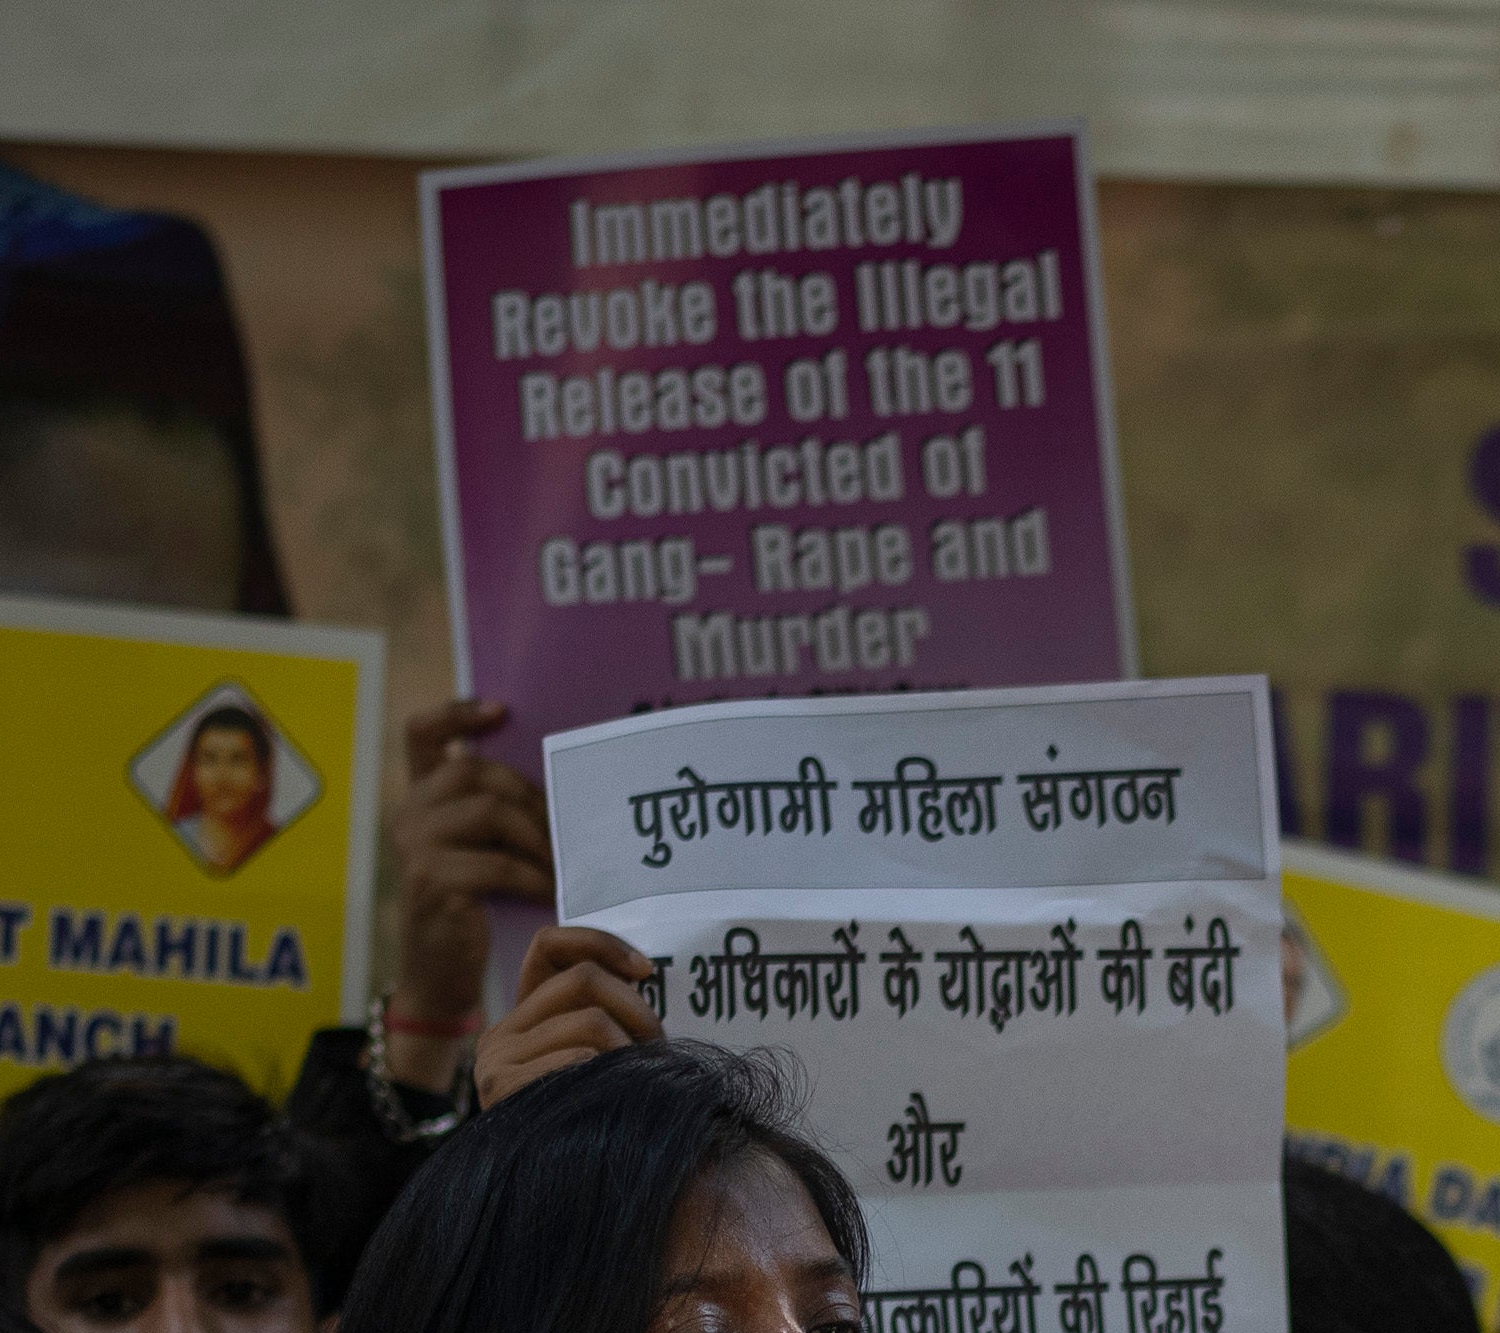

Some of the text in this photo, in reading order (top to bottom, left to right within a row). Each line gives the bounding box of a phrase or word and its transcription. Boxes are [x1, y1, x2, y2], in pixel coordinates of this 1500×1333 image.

[570, 172, 964, 267] Immediately
[493, 251, 1062, 359] Revoke the Illegal
[521, 339, 1045, 440] Release of the 11
[586, 426, 986, 518] Convicted of
[541, 508, 1050, 605] Gang- Rape and
[672, 606, 928, 681] Murder
[630, 745, 1180, 868] पुरोगामी महिला संगठन
[51, 912, 309, 986] MAHILA
[688, 919, 864, 1023] अधिकारों
[881, 928, 922, 1021] के
[1100, 921, 1152, 1016] की
[1166, 917, 1239, 1016] बंदी
[888, 1093, 964, 1186] और
